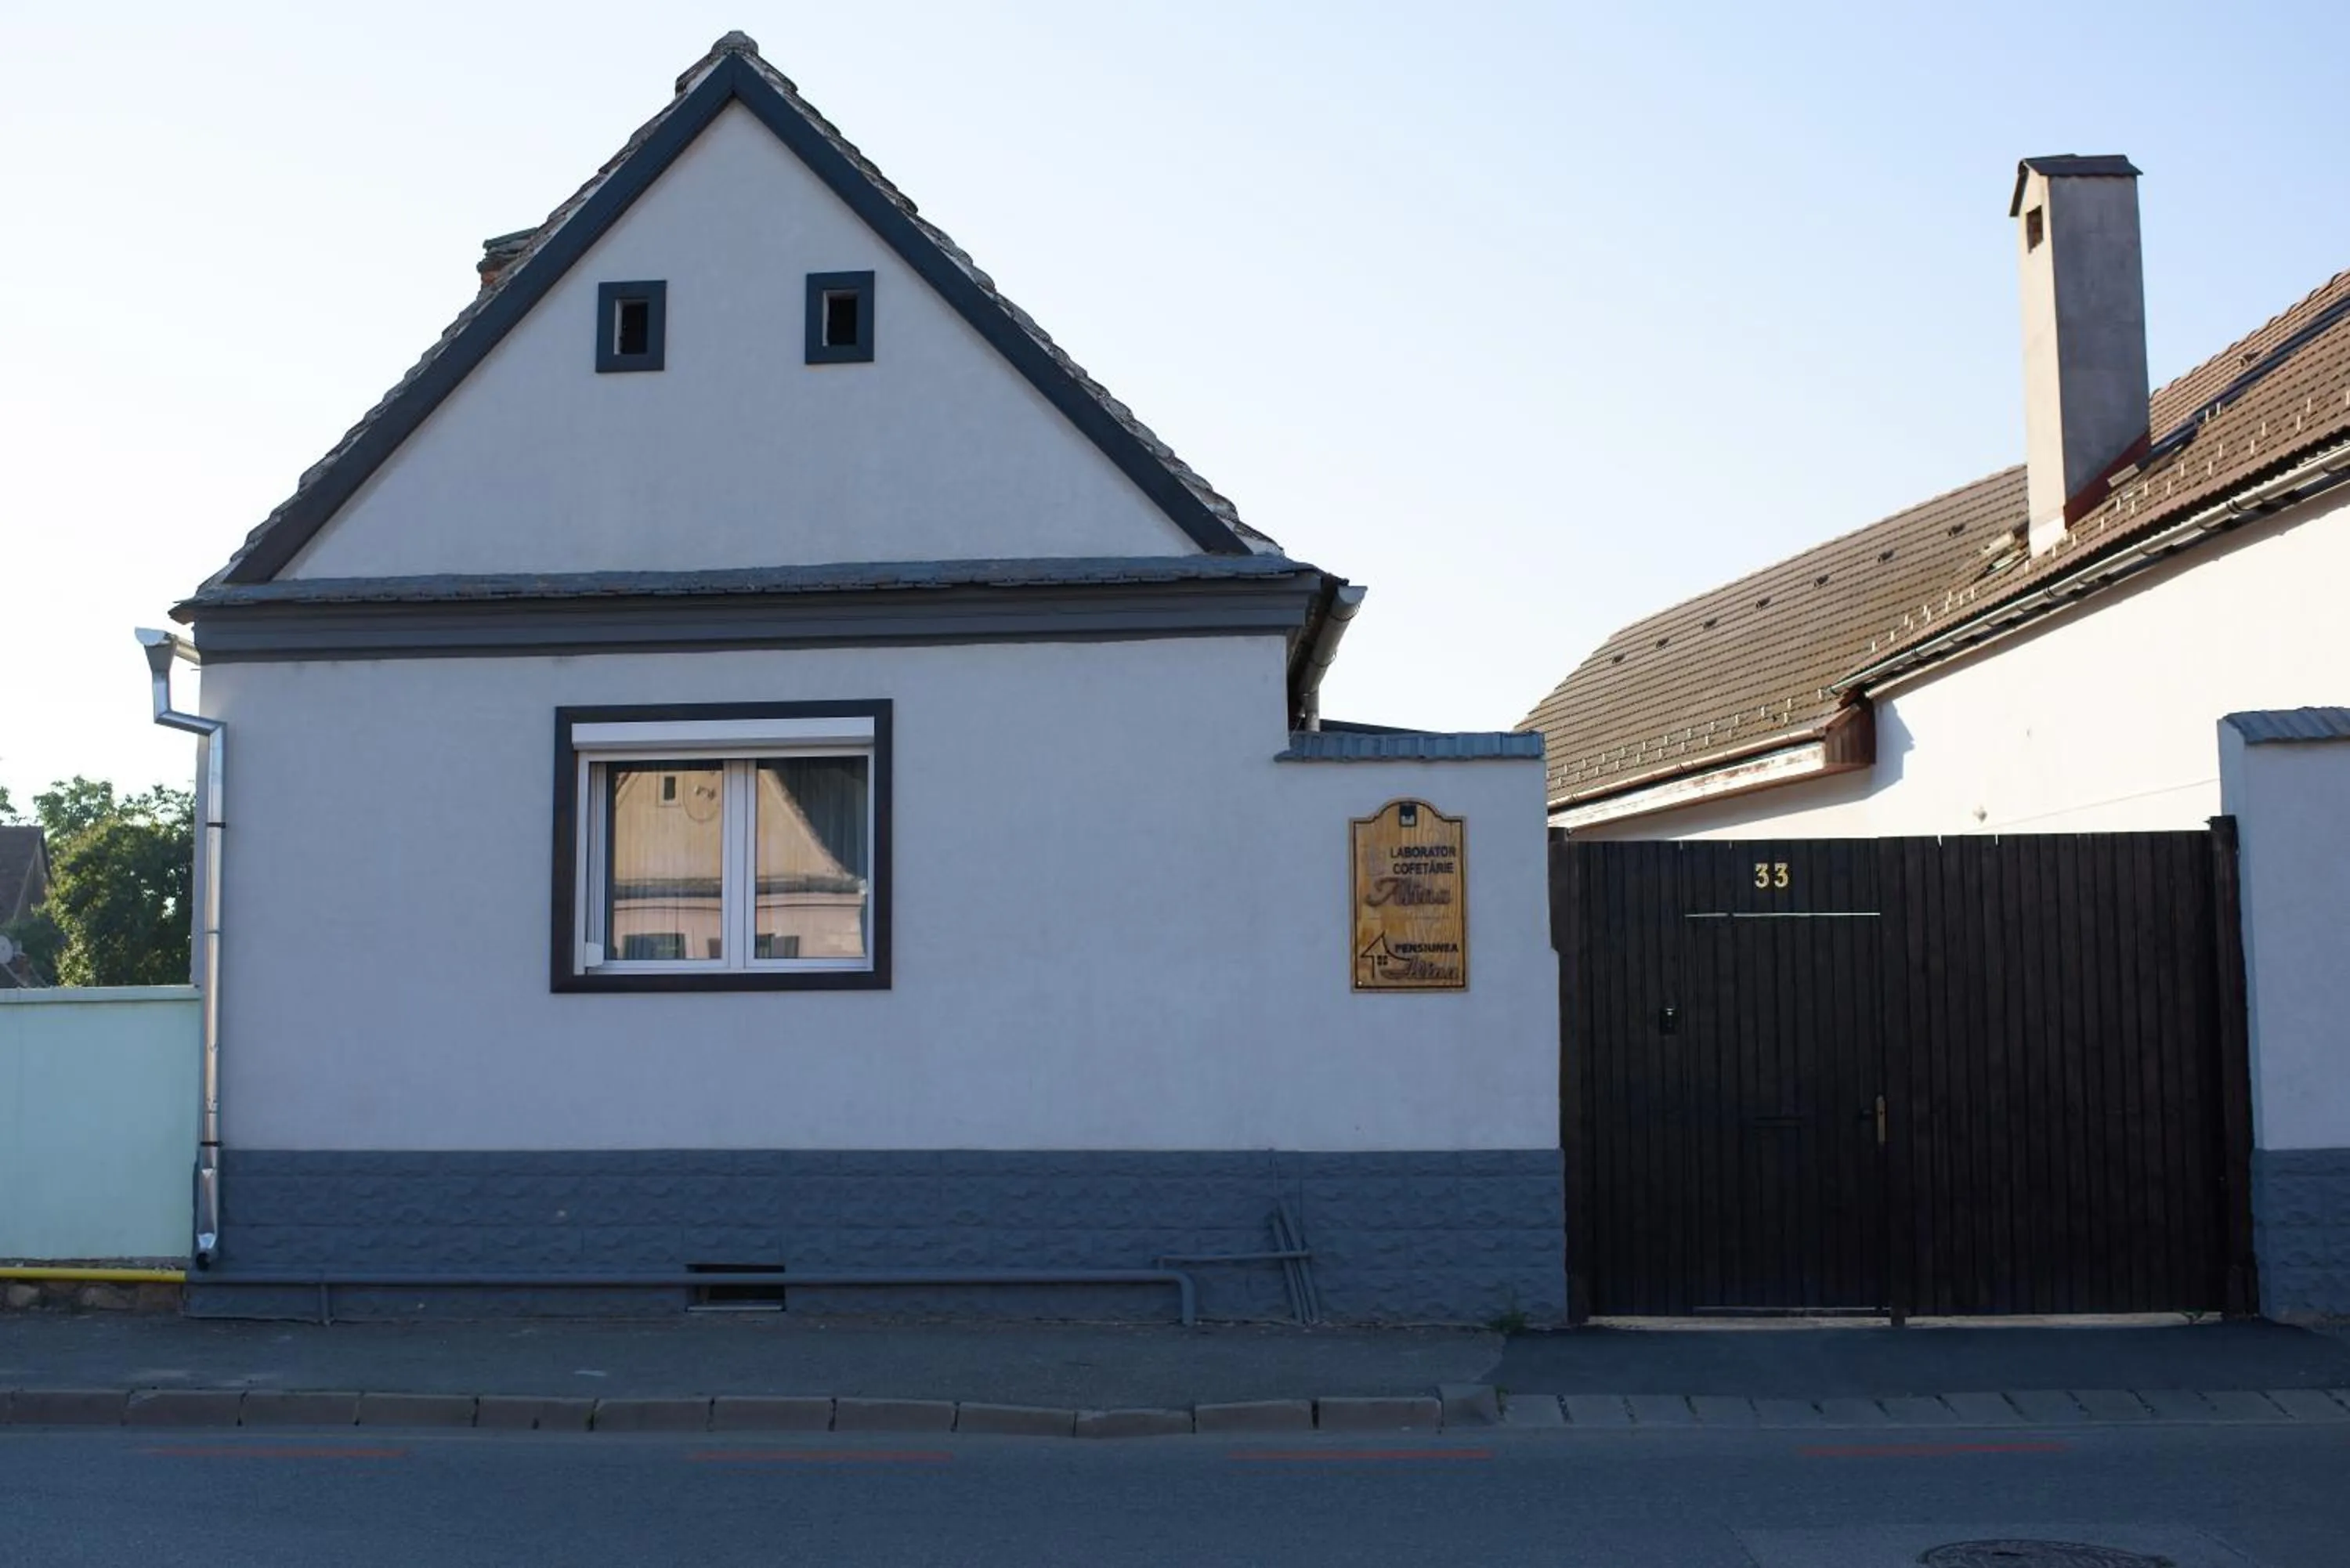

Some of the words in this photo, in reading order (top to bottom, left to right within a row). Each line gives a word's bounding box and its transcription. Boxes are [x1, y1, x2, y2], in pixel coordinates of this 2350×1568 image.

[1390, 846, 1456, 858] LABORATOR
[1755, 862, 1789, 888] 33
[1394, 942, 1459, 953] PENSIUNEA
